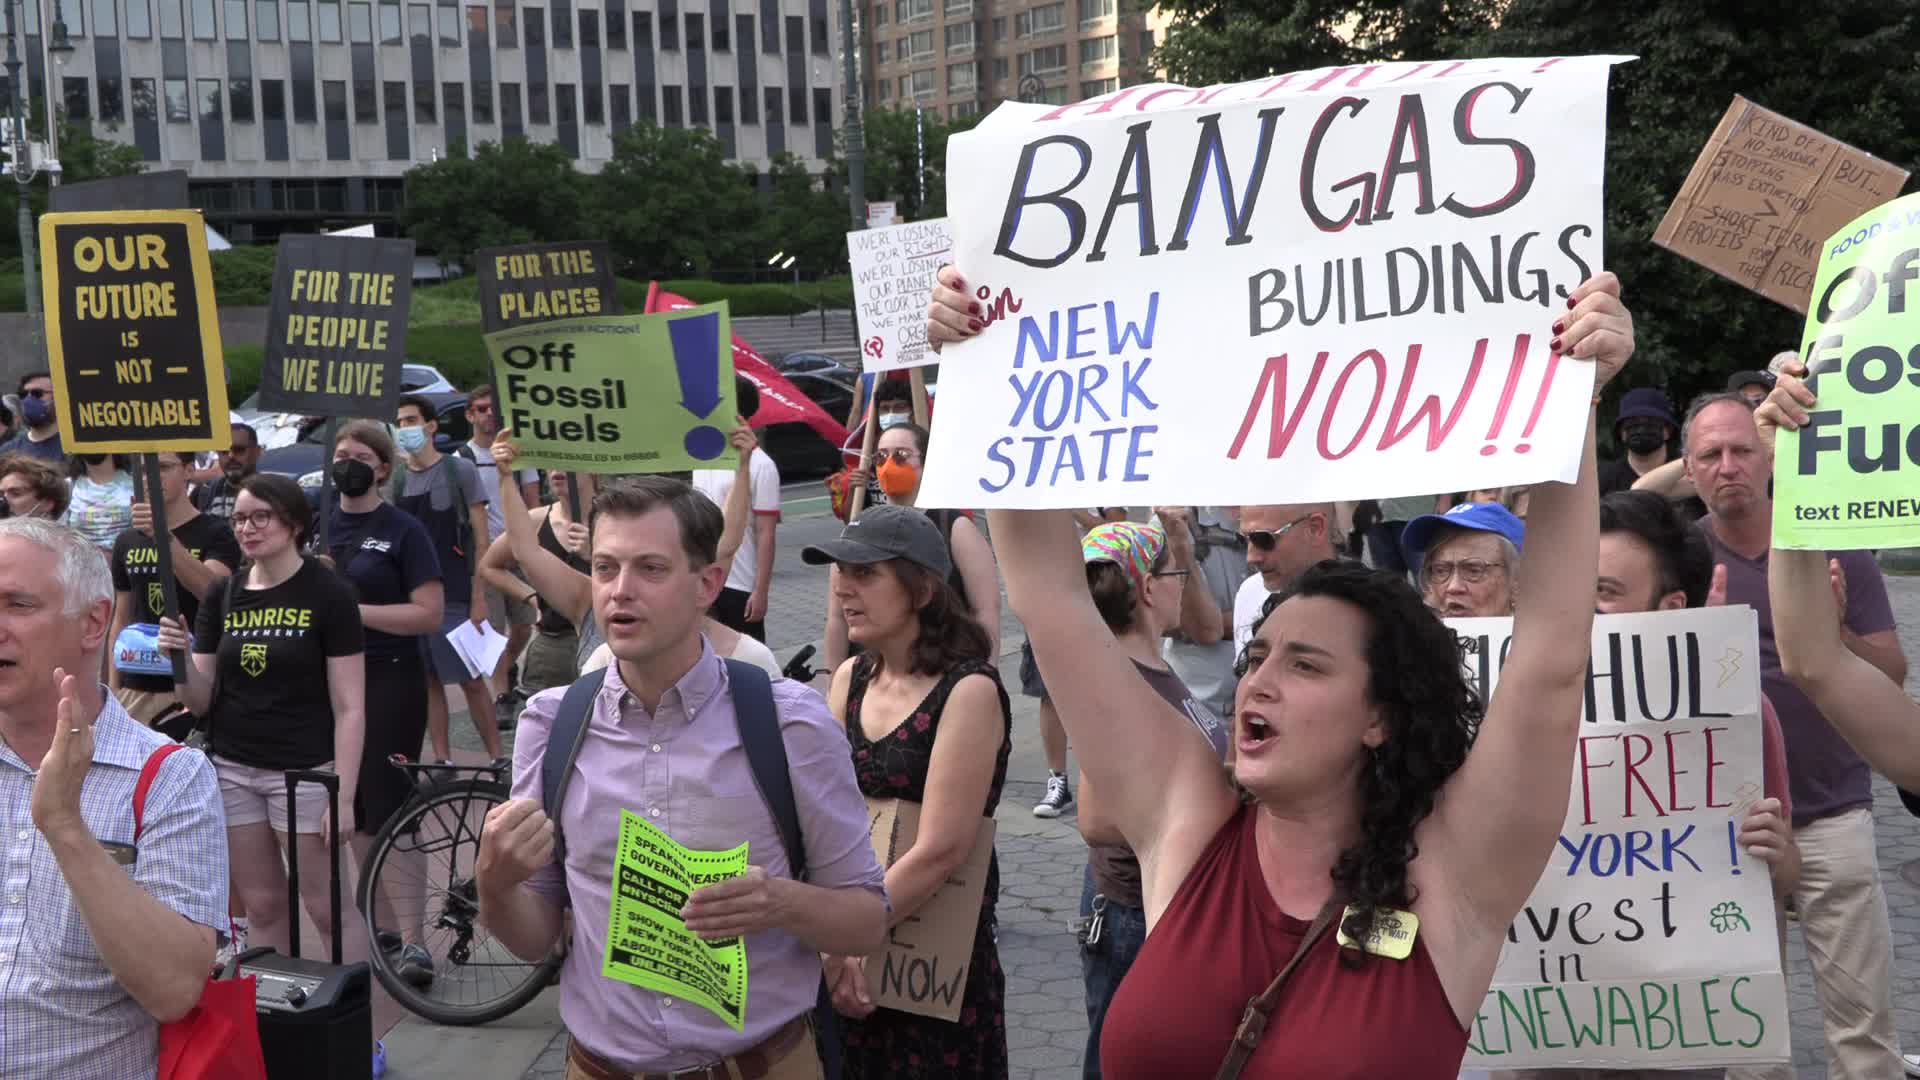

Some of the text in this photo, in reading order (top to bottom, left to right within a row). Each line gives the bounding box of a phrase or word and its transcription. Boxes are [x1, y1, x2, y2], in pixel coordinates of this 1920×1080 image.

[993, 81, 1536, 269] BAN GAS
[1713, 151, 1785, 182] STOPPING
[875, 234, 952, 262] OUR RIGHTS
[897, 224, 942, 242] LOSING
[1683, 220, 1747, 250] PROFITS
[1704, 206, 1816, 257] SHORT TERM
[73, 234, 170, 273] OUR
[496, 249, 595, 280] FOR THE
[291, 269, 395, 306] FOR THE
[869, 281, 892, 300] OUR
[1249, 223, 1592, 337] BUILDINGS
[76, 282, 177, 320] FUTURE
[499, 287, 601, 320] PLACES
[862, 300, 883, 318] THE
[912, 292, 928, 309] IS
[977, 285, 1023, 327] in
[286, 314, 389, 351] PEOPLE
[872, 311, 925, 328] WE HAVE
[1013, 292, 1159, 368] NEW
[121, 331, 139, 347] IS
[116, 358, 152, 384] NOT
[502, 342, 576, 373] Off
[282, 357, 384, 396] WE LOVE
[507, 374, 627, 410] Fossil
[1008, 358, 1159, 432] YORK
[1226, 334, 1562, 461] NOW!!
[79, 399, 201, 429] NEGOTIABLE
[511, 409, 620, 443] Fuels
[979, 425, 1158, 493] STATE
[1794, 504, 1840, 520] text
[224, 607, 312, 632] SUNRISE
[224, 629, 306, 637] OVEMENT
[1578, 727, 1733, 826] FREE
[635, 836, 686, 874] SPEAKER
[1559, 824, 1703, 877] YORK
[622, 870, 683, 904] CALL FOR
[628, 911, 664, 933] SHOW
[667, 928, 691, 945] THE
[1508, 882, 1677, 944] vest
[620, 938, 664, 958] ABOUT
[628, 925, 658, 942] NEW
[662, 938, 693, 958] YORK
[630, 956, 680, 978] UNLIKE
[881, 952, 963, 1008] NOW
[1539, 949, 1587, 983] in
[1467, 977, 1765, 1056] ENEWABLES
